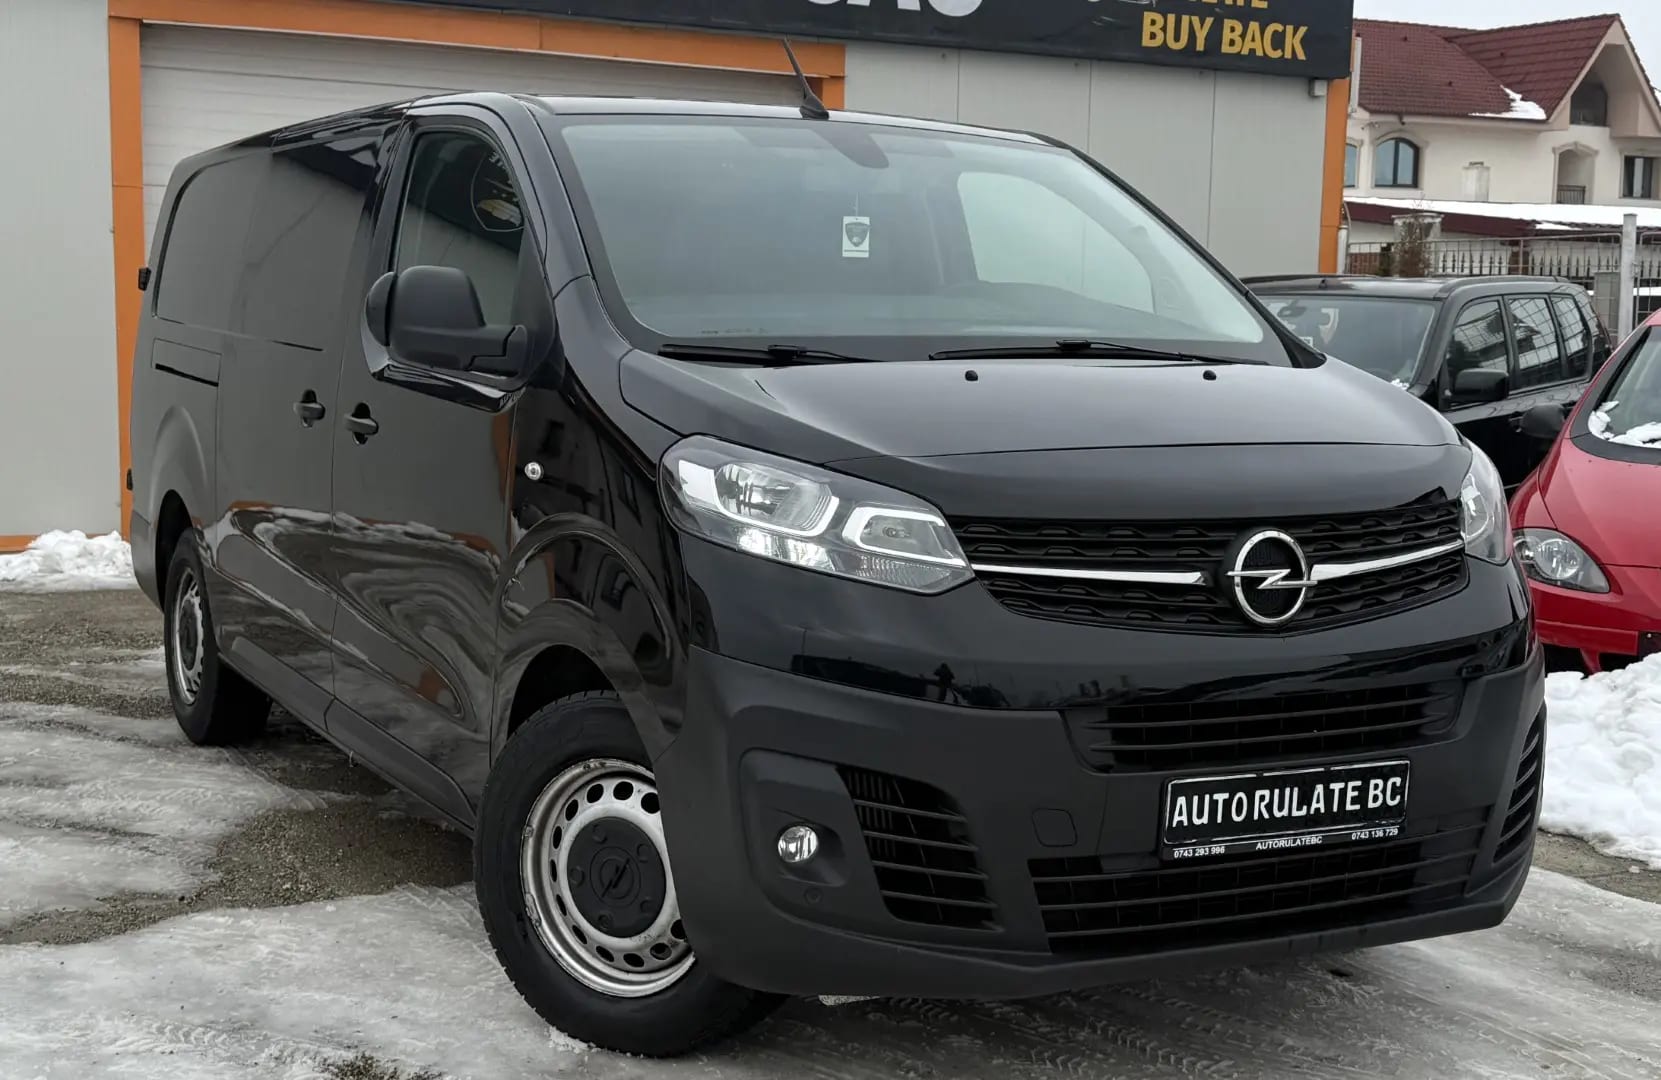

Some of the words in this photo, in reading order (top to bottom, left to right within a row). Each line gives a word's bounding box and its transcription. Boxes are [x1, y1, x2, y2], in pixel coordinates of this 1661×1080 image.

[1141, 11, 1214, 52] BUY
[1221, 18, 1308, 60] BACK
[1367, 777, 1401, 809] BC
[1351, 831, 1369, 841] 0743
[1385, 828, 1399, 837] 729
[1255, 836, 1323, 850] AUTORULATEBC
[1174, 850, 1193, 860] 0743
[1194, 848, 1209, 857] 293
